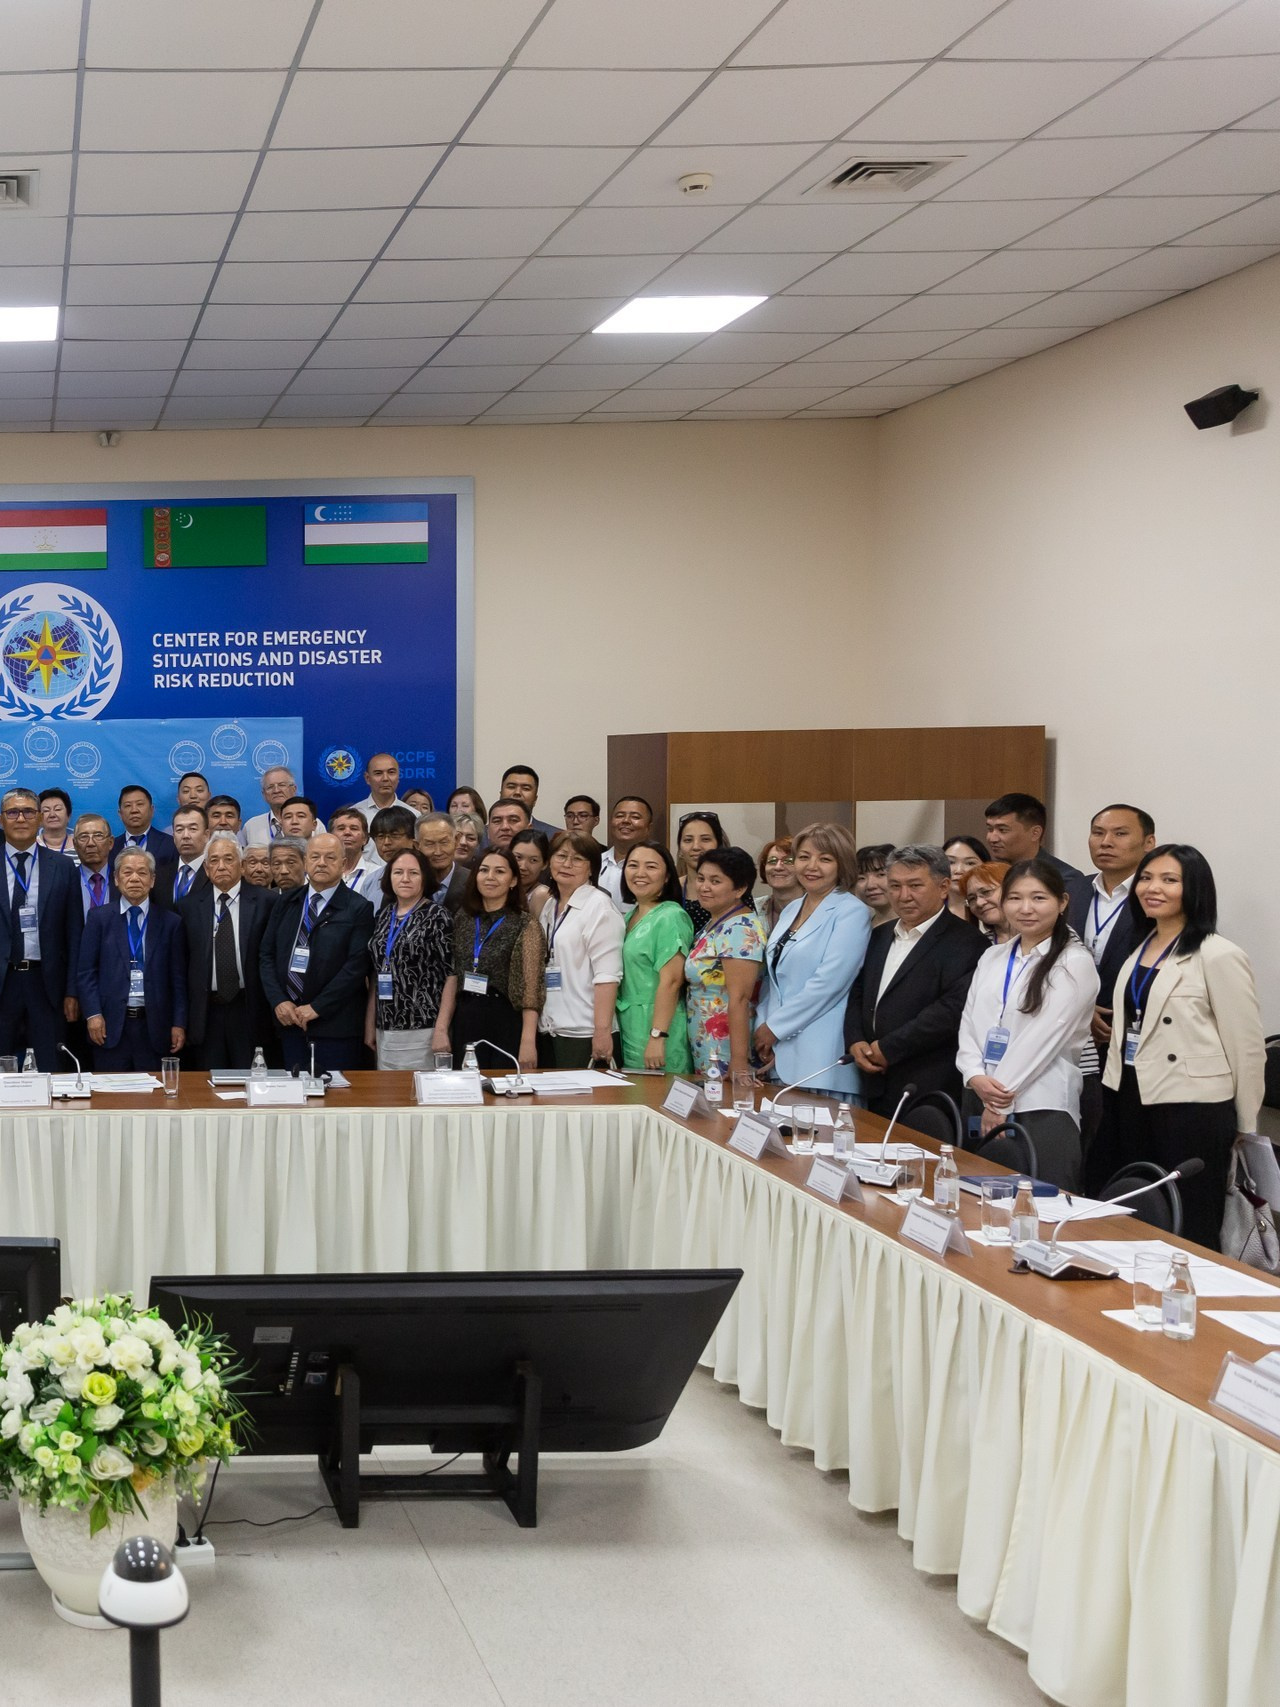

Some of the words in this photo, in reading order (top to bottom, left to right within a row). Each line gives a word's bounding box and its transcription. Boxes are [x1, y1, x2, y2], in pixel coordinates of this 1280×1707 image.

[152, 632, 220, 648] CENTER
[225, 631, 258, 647] FOR
[263, 629, 367, 646] EMERGENCY
[152, 651, 253, 668] SITUATIONS
[257, 651, 294, 667] AND
[298, 649, 383, 666] DISASTER
[154, 673, 194, 689] RISK
[198, 671, 295, 688] REDUCTION
